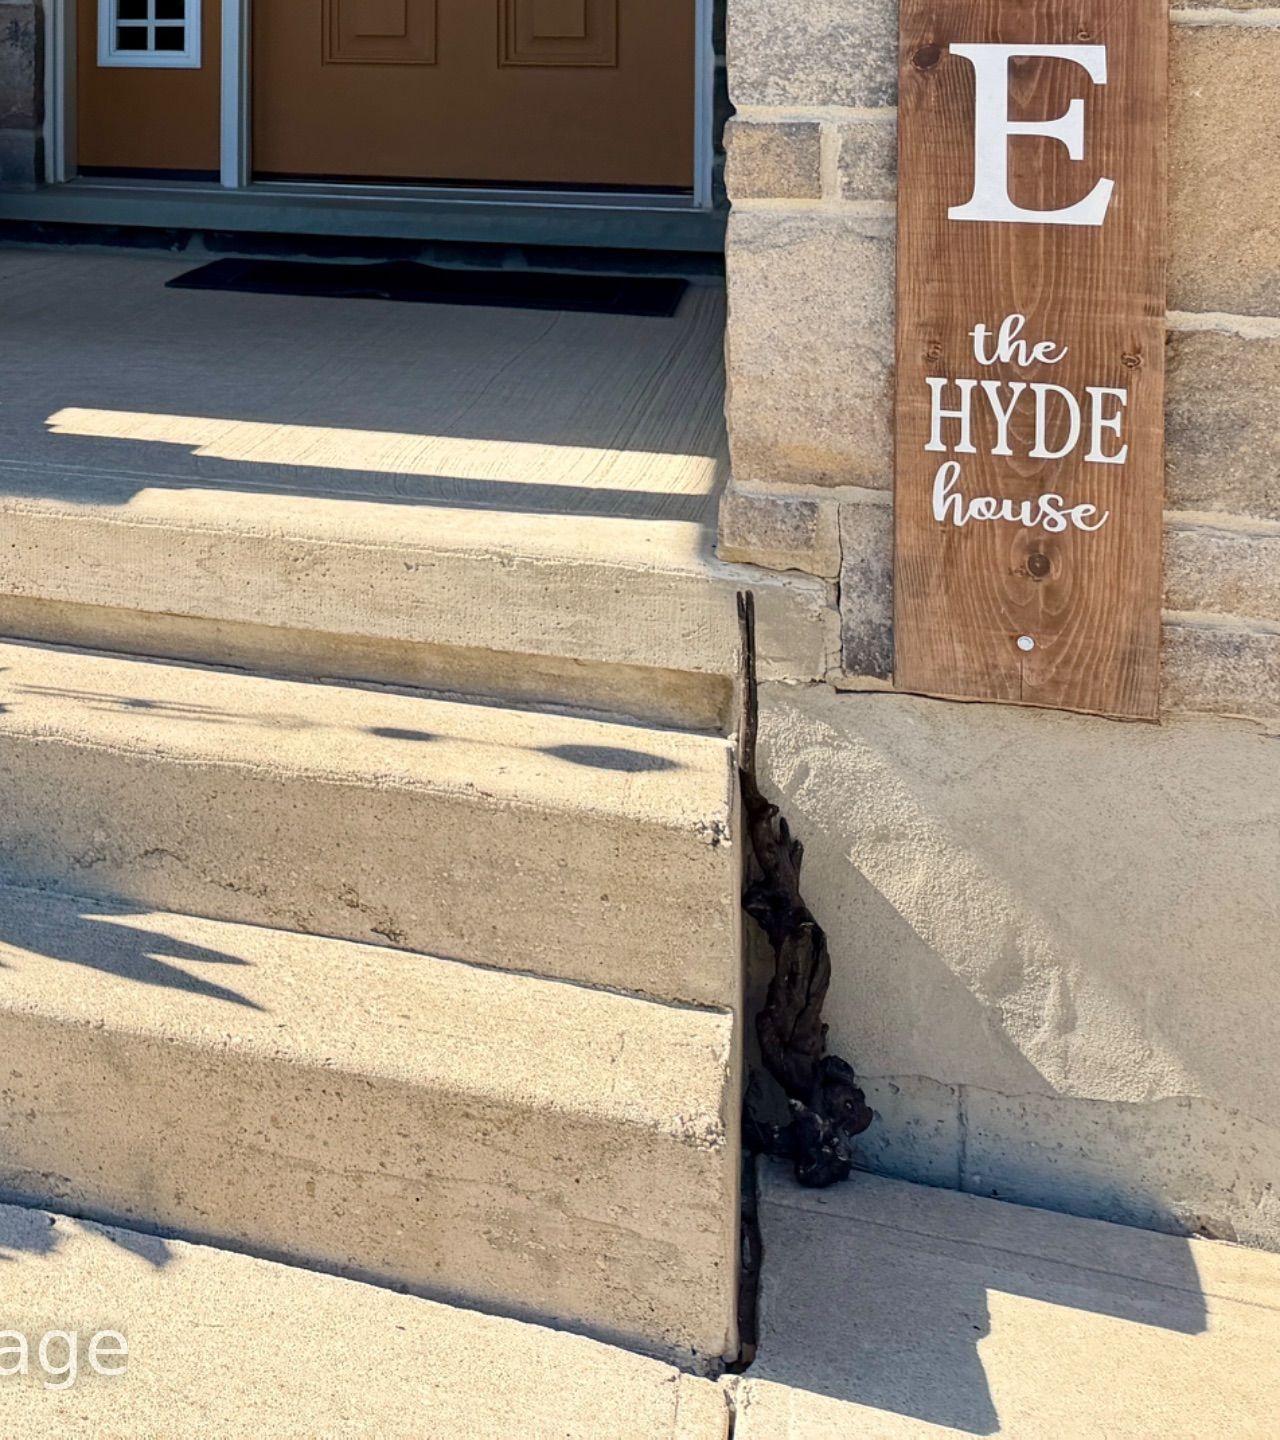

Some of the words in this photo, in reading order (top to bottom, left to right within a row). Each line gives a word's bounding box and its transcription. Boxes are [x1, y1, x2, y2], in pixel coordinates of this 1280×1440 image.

[969, 313, 1068, 367] the
[925, 376, 1128, 465] HYDE
[931, 461, 1110, 533] house
